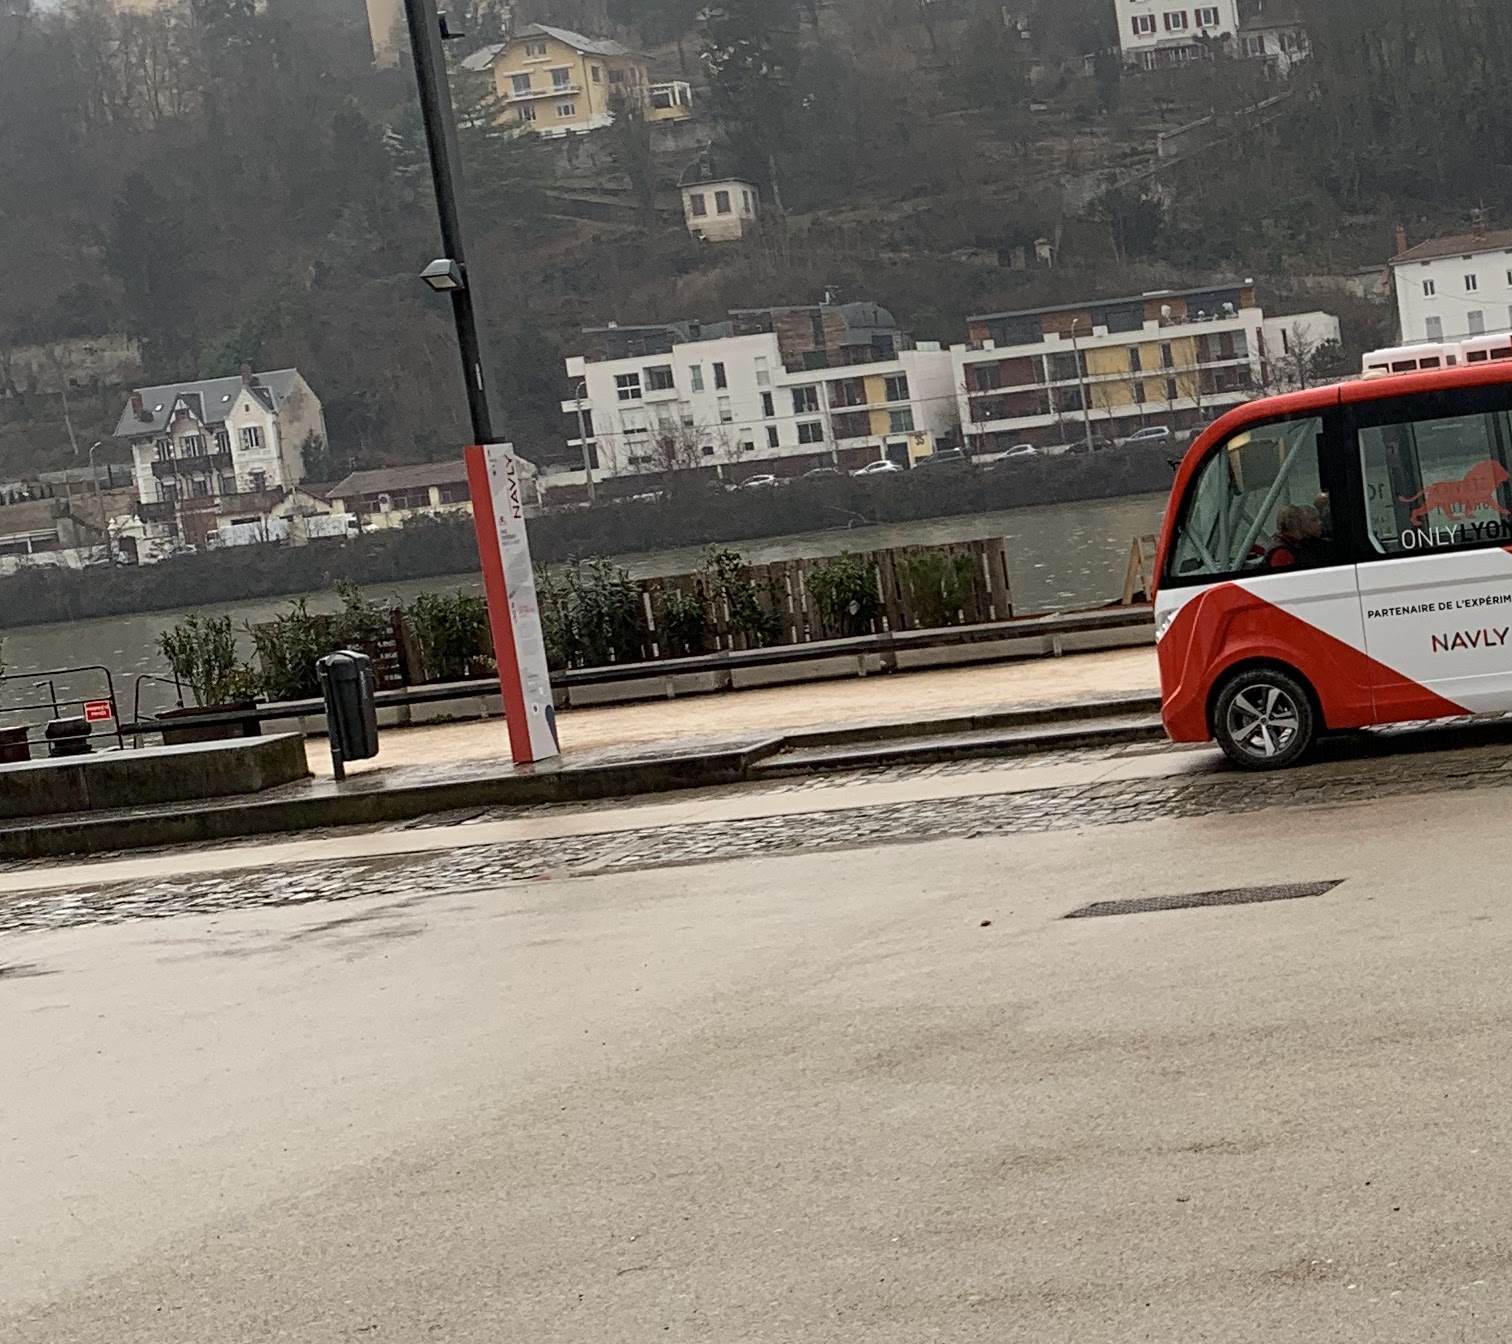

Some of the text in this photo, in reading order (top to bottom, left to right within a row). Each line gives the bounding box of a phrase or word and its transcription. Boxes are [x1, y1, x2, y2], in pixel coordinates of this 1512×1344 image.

[504, 454, 521, 518] NAVLY
[1367, 602, 1436, 619] PARTENAIRE
[1438, 600, 1453, 611] DE
[1431, 626, 1510, 653] NAVLY
